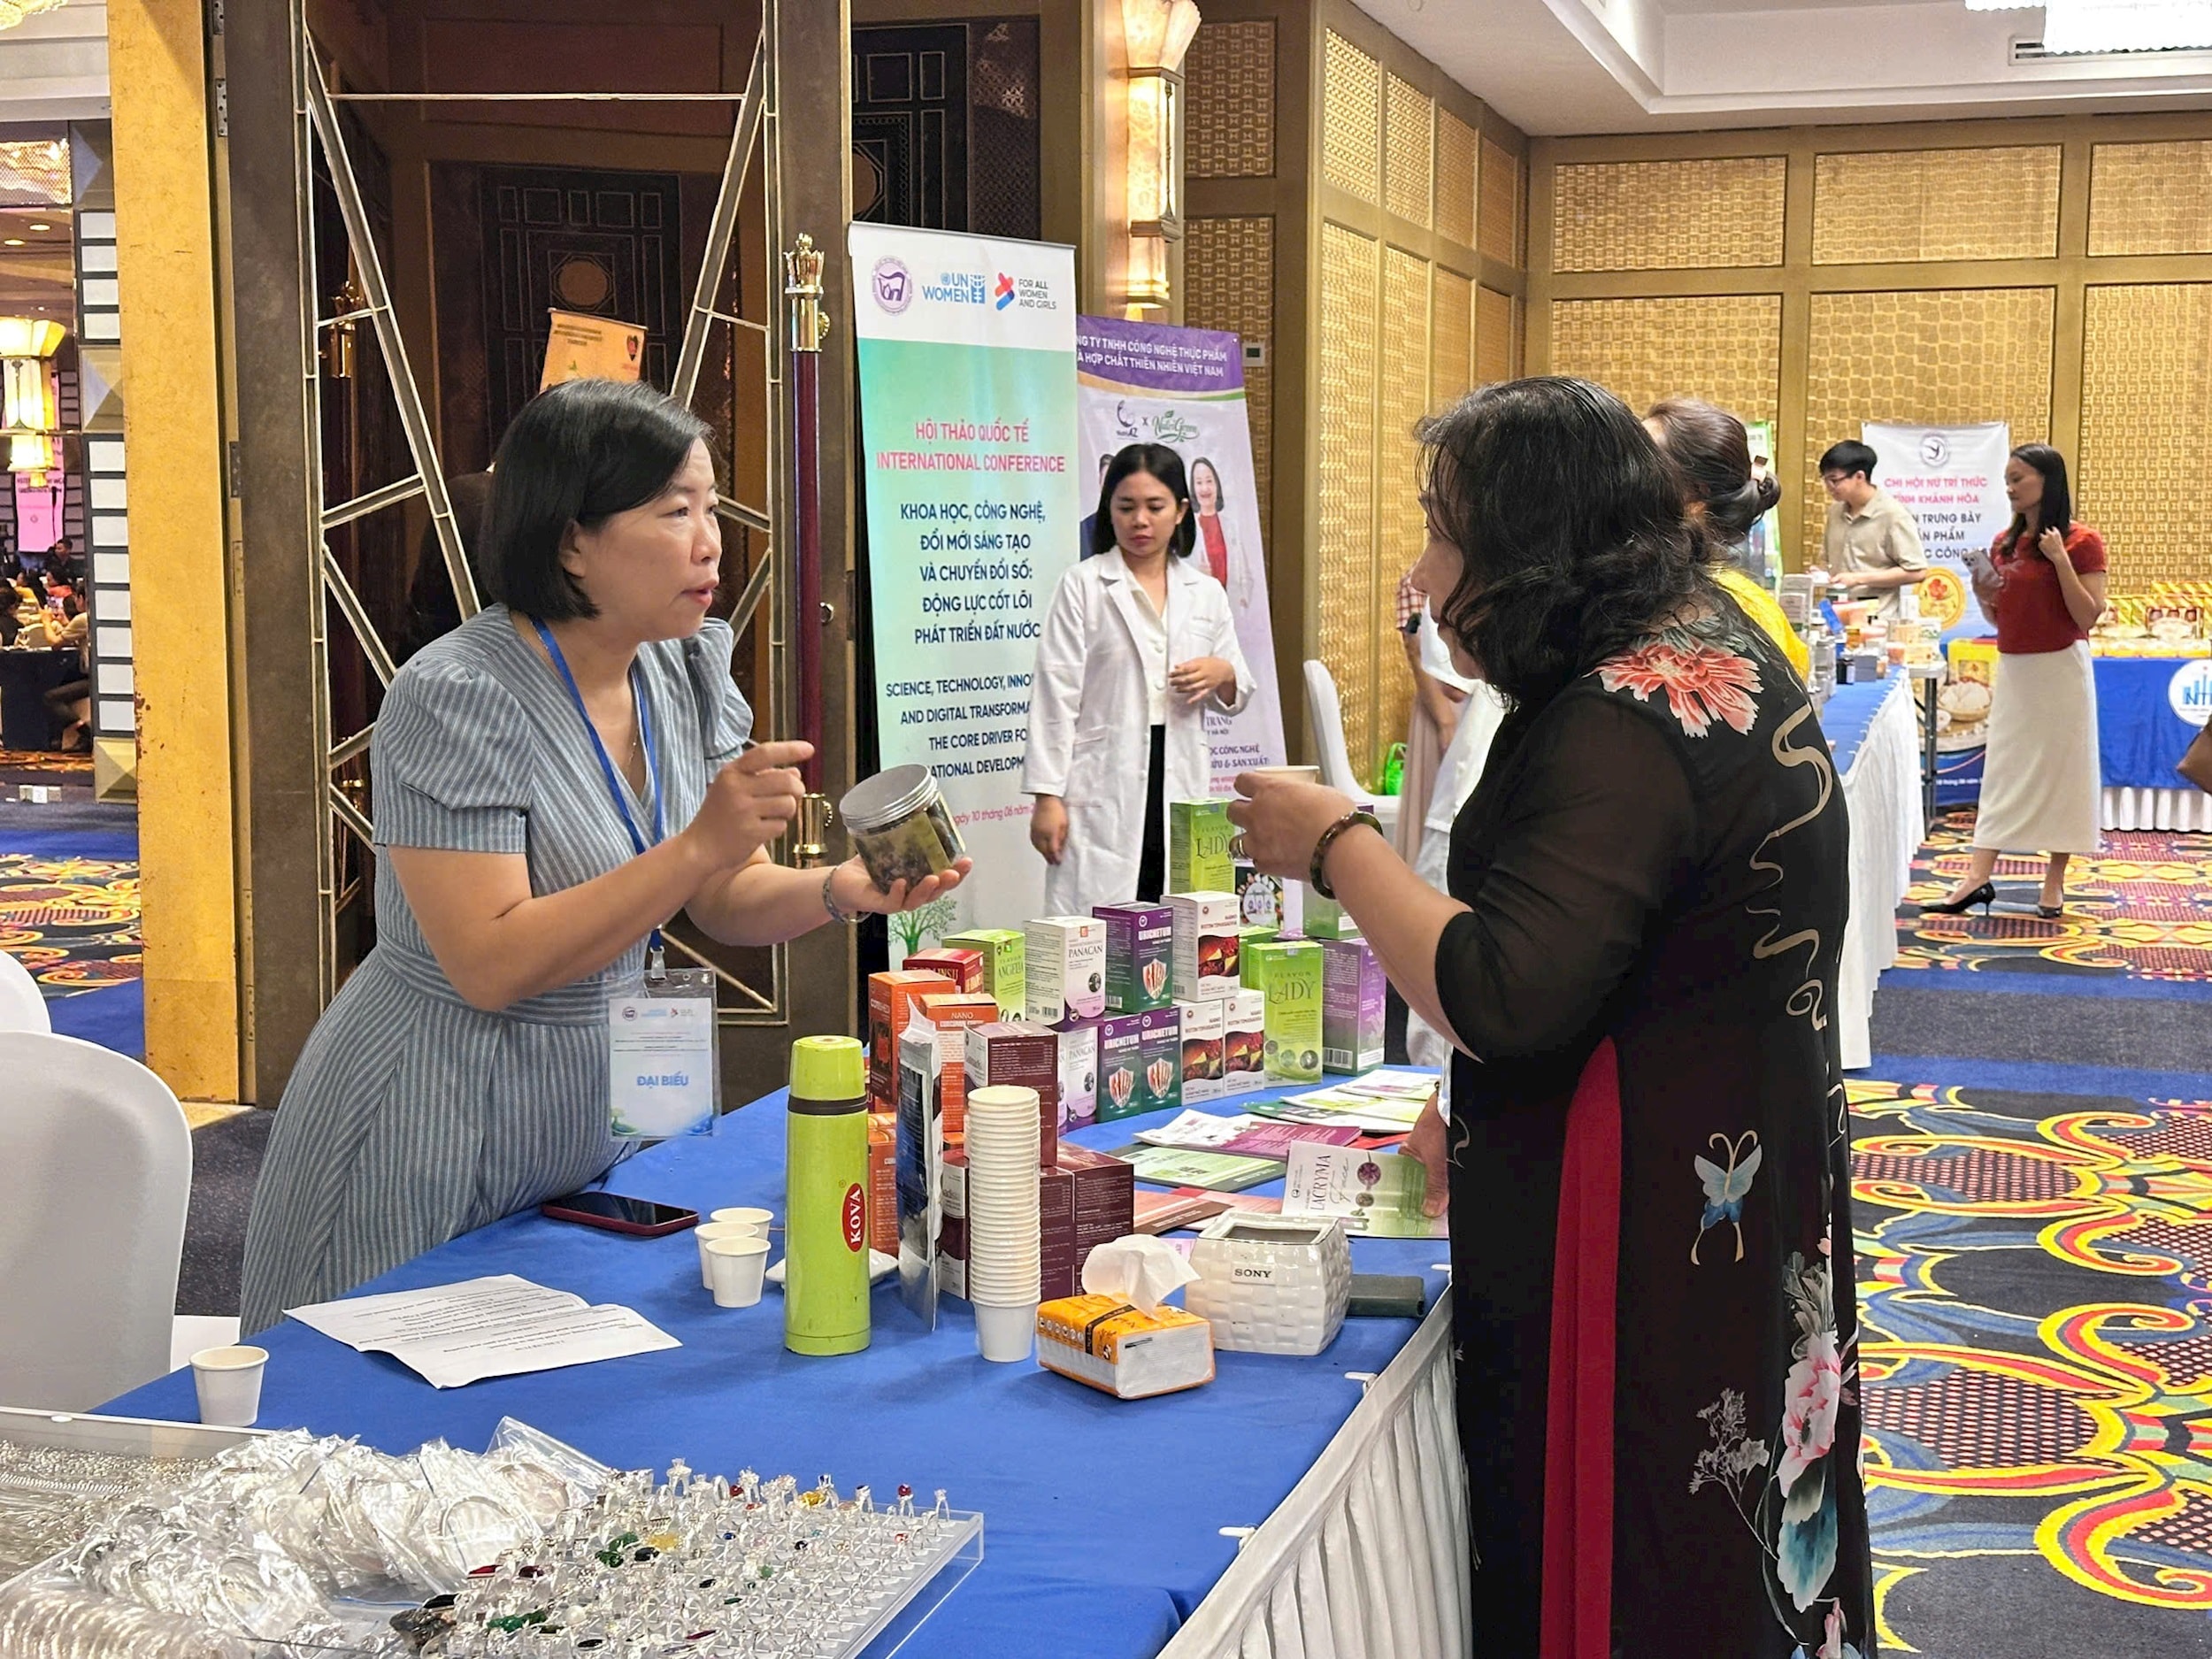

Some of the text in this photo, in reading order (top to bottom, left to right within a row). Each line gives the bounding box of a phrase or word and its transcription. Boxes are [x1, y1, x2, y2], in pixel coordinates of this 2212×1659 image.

[952, 273, 969, 286] UN
[1018, 279, 1048, 289] FOR ALL
[922, 285, 969, 303] WOMEN
[1018, 288, 1048, 299] WOMEN
[1018, 299, 1056, 310] AND GIRLS
[1090, 337, 1101, 348] TY
[1102, 338, 1126, 351] TNHH
[1127, 339, 1152, 354] CÔNG
[1130, 356, 1156, 370] THIÊN
[1156, 359, 1184, 373] NHIÊN
[1185, 360, 1203, 377] VIỆT
[1204, 365, 1224, 377] NAM
[916, 418, 1029, 444] HỘI THẢO QUỐC TẾ
[877, 452, 1065, 472] INTERNATIONAL CONFERENCE
[1884, 478, 1902, 488] CHI
[1918, 493, 1954, 503] KHÁNH
[901, 500, 1045, 524] KHOA HỌC, CÔNG NGHỆ,
[1923, 512, 1957, 524] TRƯNG
[1961, 510, 1981, 524] BÀY
[920, 528, 1031, 554] ĐỔI MỚI SÁNG TẠO
[1933, 525, 1964, 541] PHẨM
[919, 557, 1033, 581] VÀ CHUYỂN ĐỔI SỐ:
[923, 589, 1033, 617] ĐỘNG LỰC CỐT LÕI
[915, 619, 1041, 644] PHÁT TRIỂN ĐẤT NƯỚC
[886, 681, 934, 697] SCIENCE,
[936, 677, 1006, 695] TECHNOLOGY,
[901, 710, 924, 725] AND
[926, 707, 968, 723] DIGITAL
[1206, 715, 1233, 728] TRANG
[929, 736, 951, 750] THE
[951, 733, 979, 749] CORE
[981, 730, 1013, 746] DRIVER
[930, 757, 1025, 780] ATIONAL DEVELOPM
[1068, 944, 1103, 958] PANACAN
[1267, 978, 1316, 1005] LADY
[951, 1011, 974, 1020] NANO
[636, 1075, 658, 1089] ĐẠI
[1310, 1154, 1332, 1211] LACRYMA
[849, 1188, 862, 1244] KOVA
[1234, 1269, 1272, 1279] SONY
